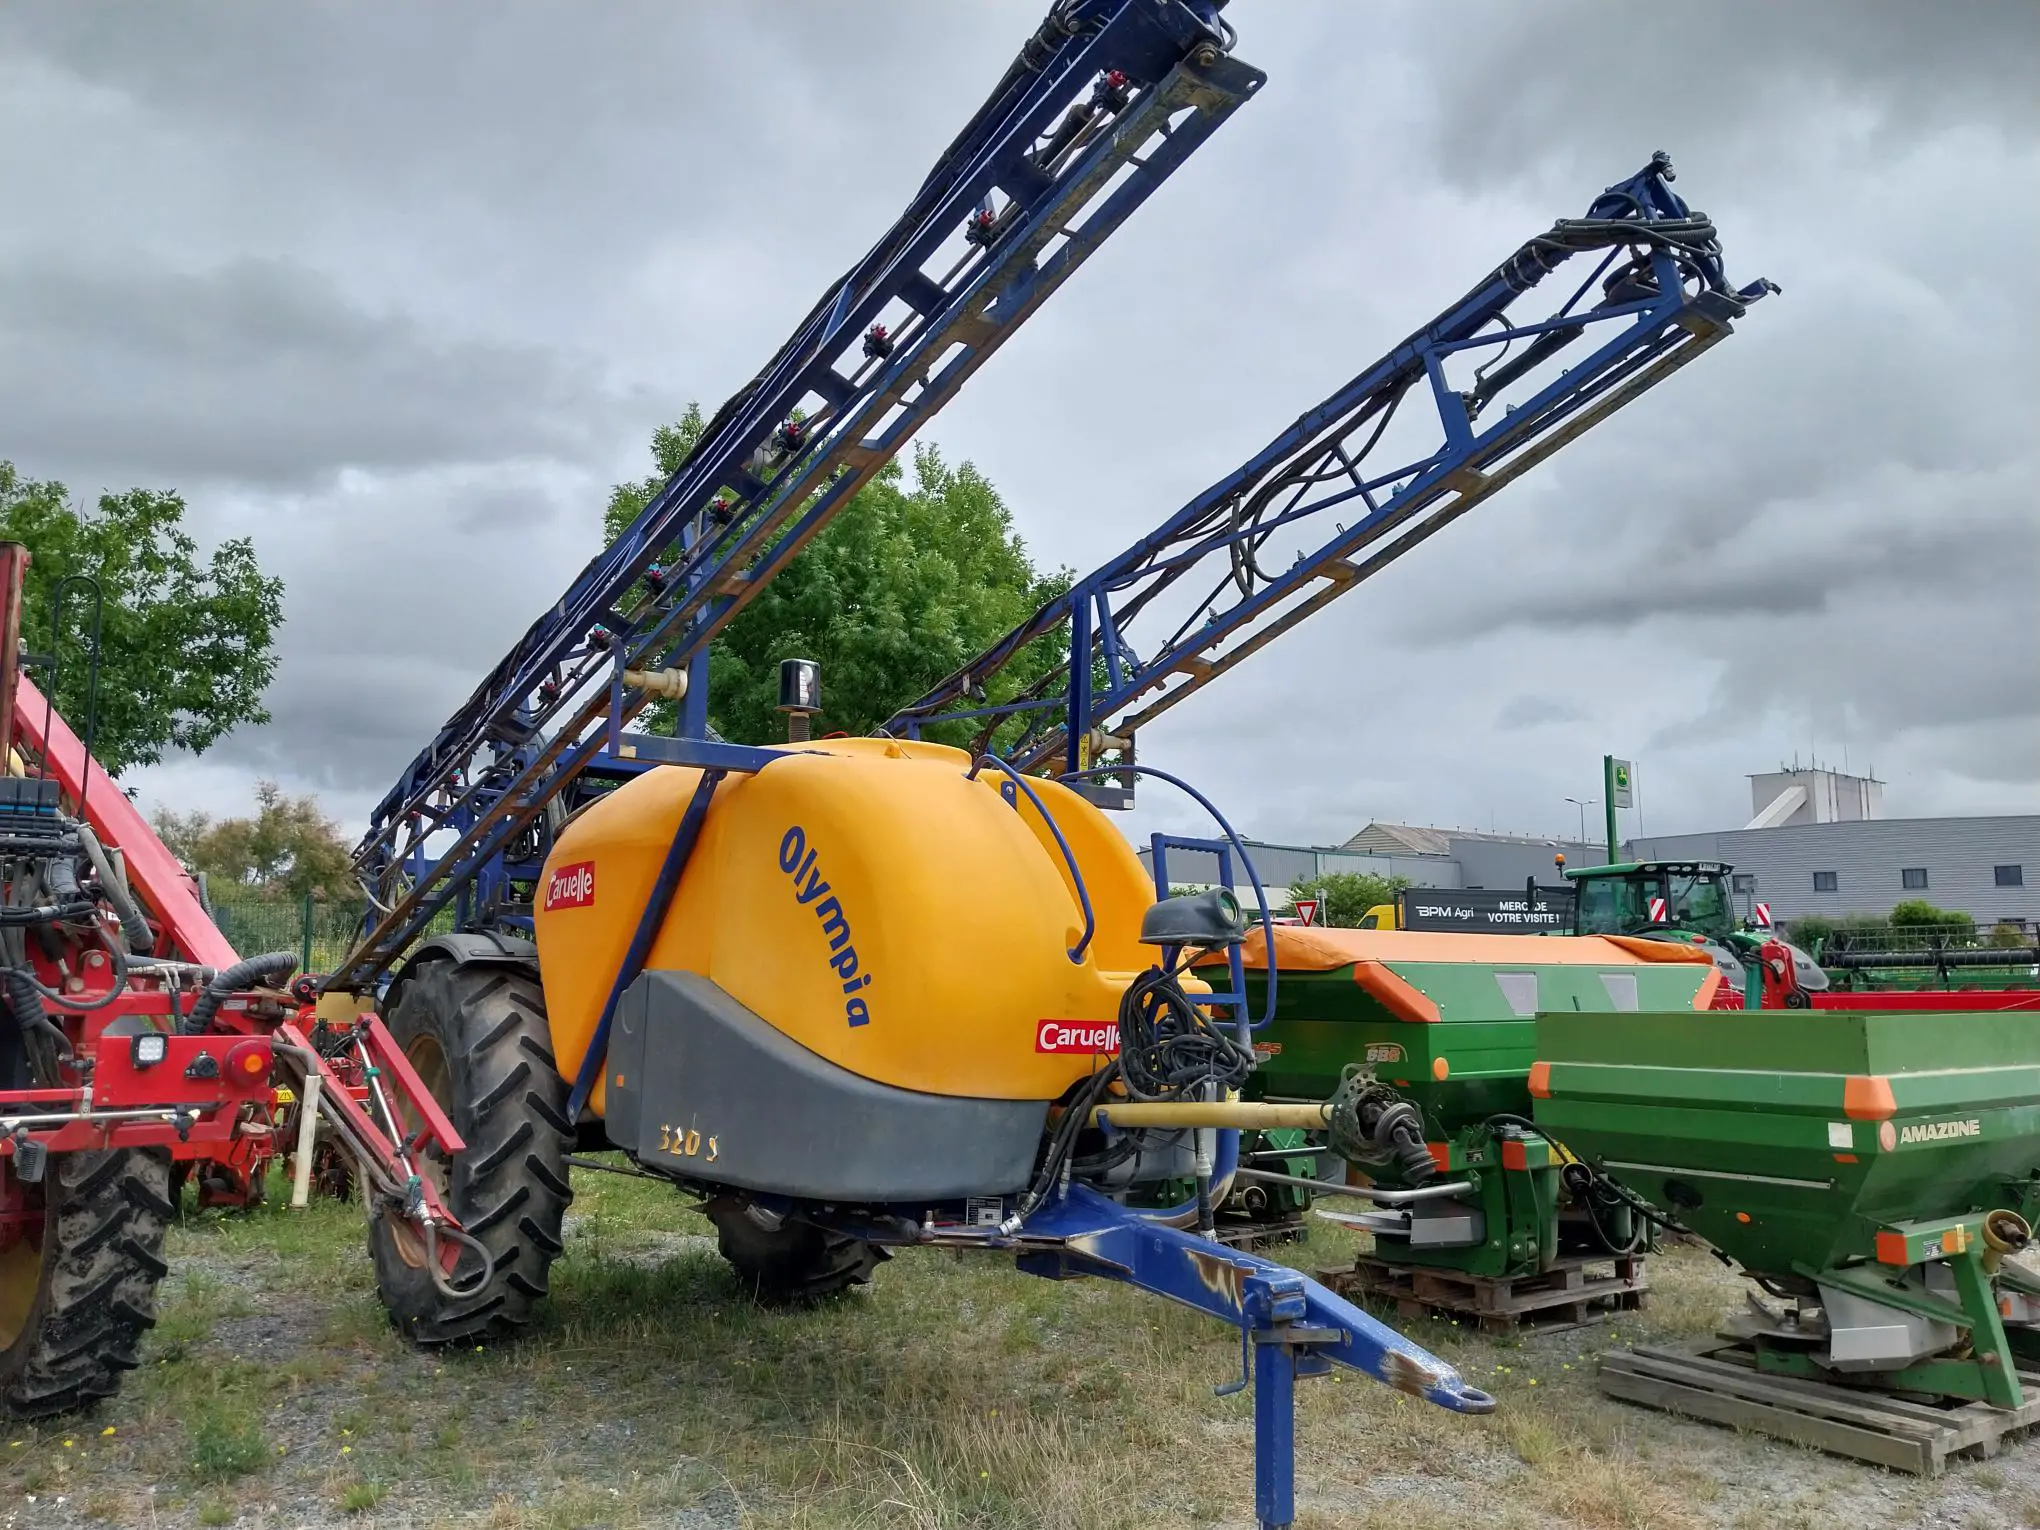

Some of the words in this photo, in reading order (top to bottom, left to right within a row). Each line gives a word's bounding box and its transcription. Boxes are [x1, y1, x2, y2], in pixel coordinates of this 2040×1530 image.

[547, 867, 593, 908] Caruelle
[1415, 905, 1452, 917] BPM
[1454, 907, 1474, 920] Agri
[1499, 901, 1531, 912] MERC
[1533, 901, 1548, 912] DE
[779, 825, 871, 1028] Olympia
[1487, 912, 1522, 923] VOTRE
[1523, 913, 1555, 923] VISITE
[1900, 1119, 1981, 1144] AMAZONE
